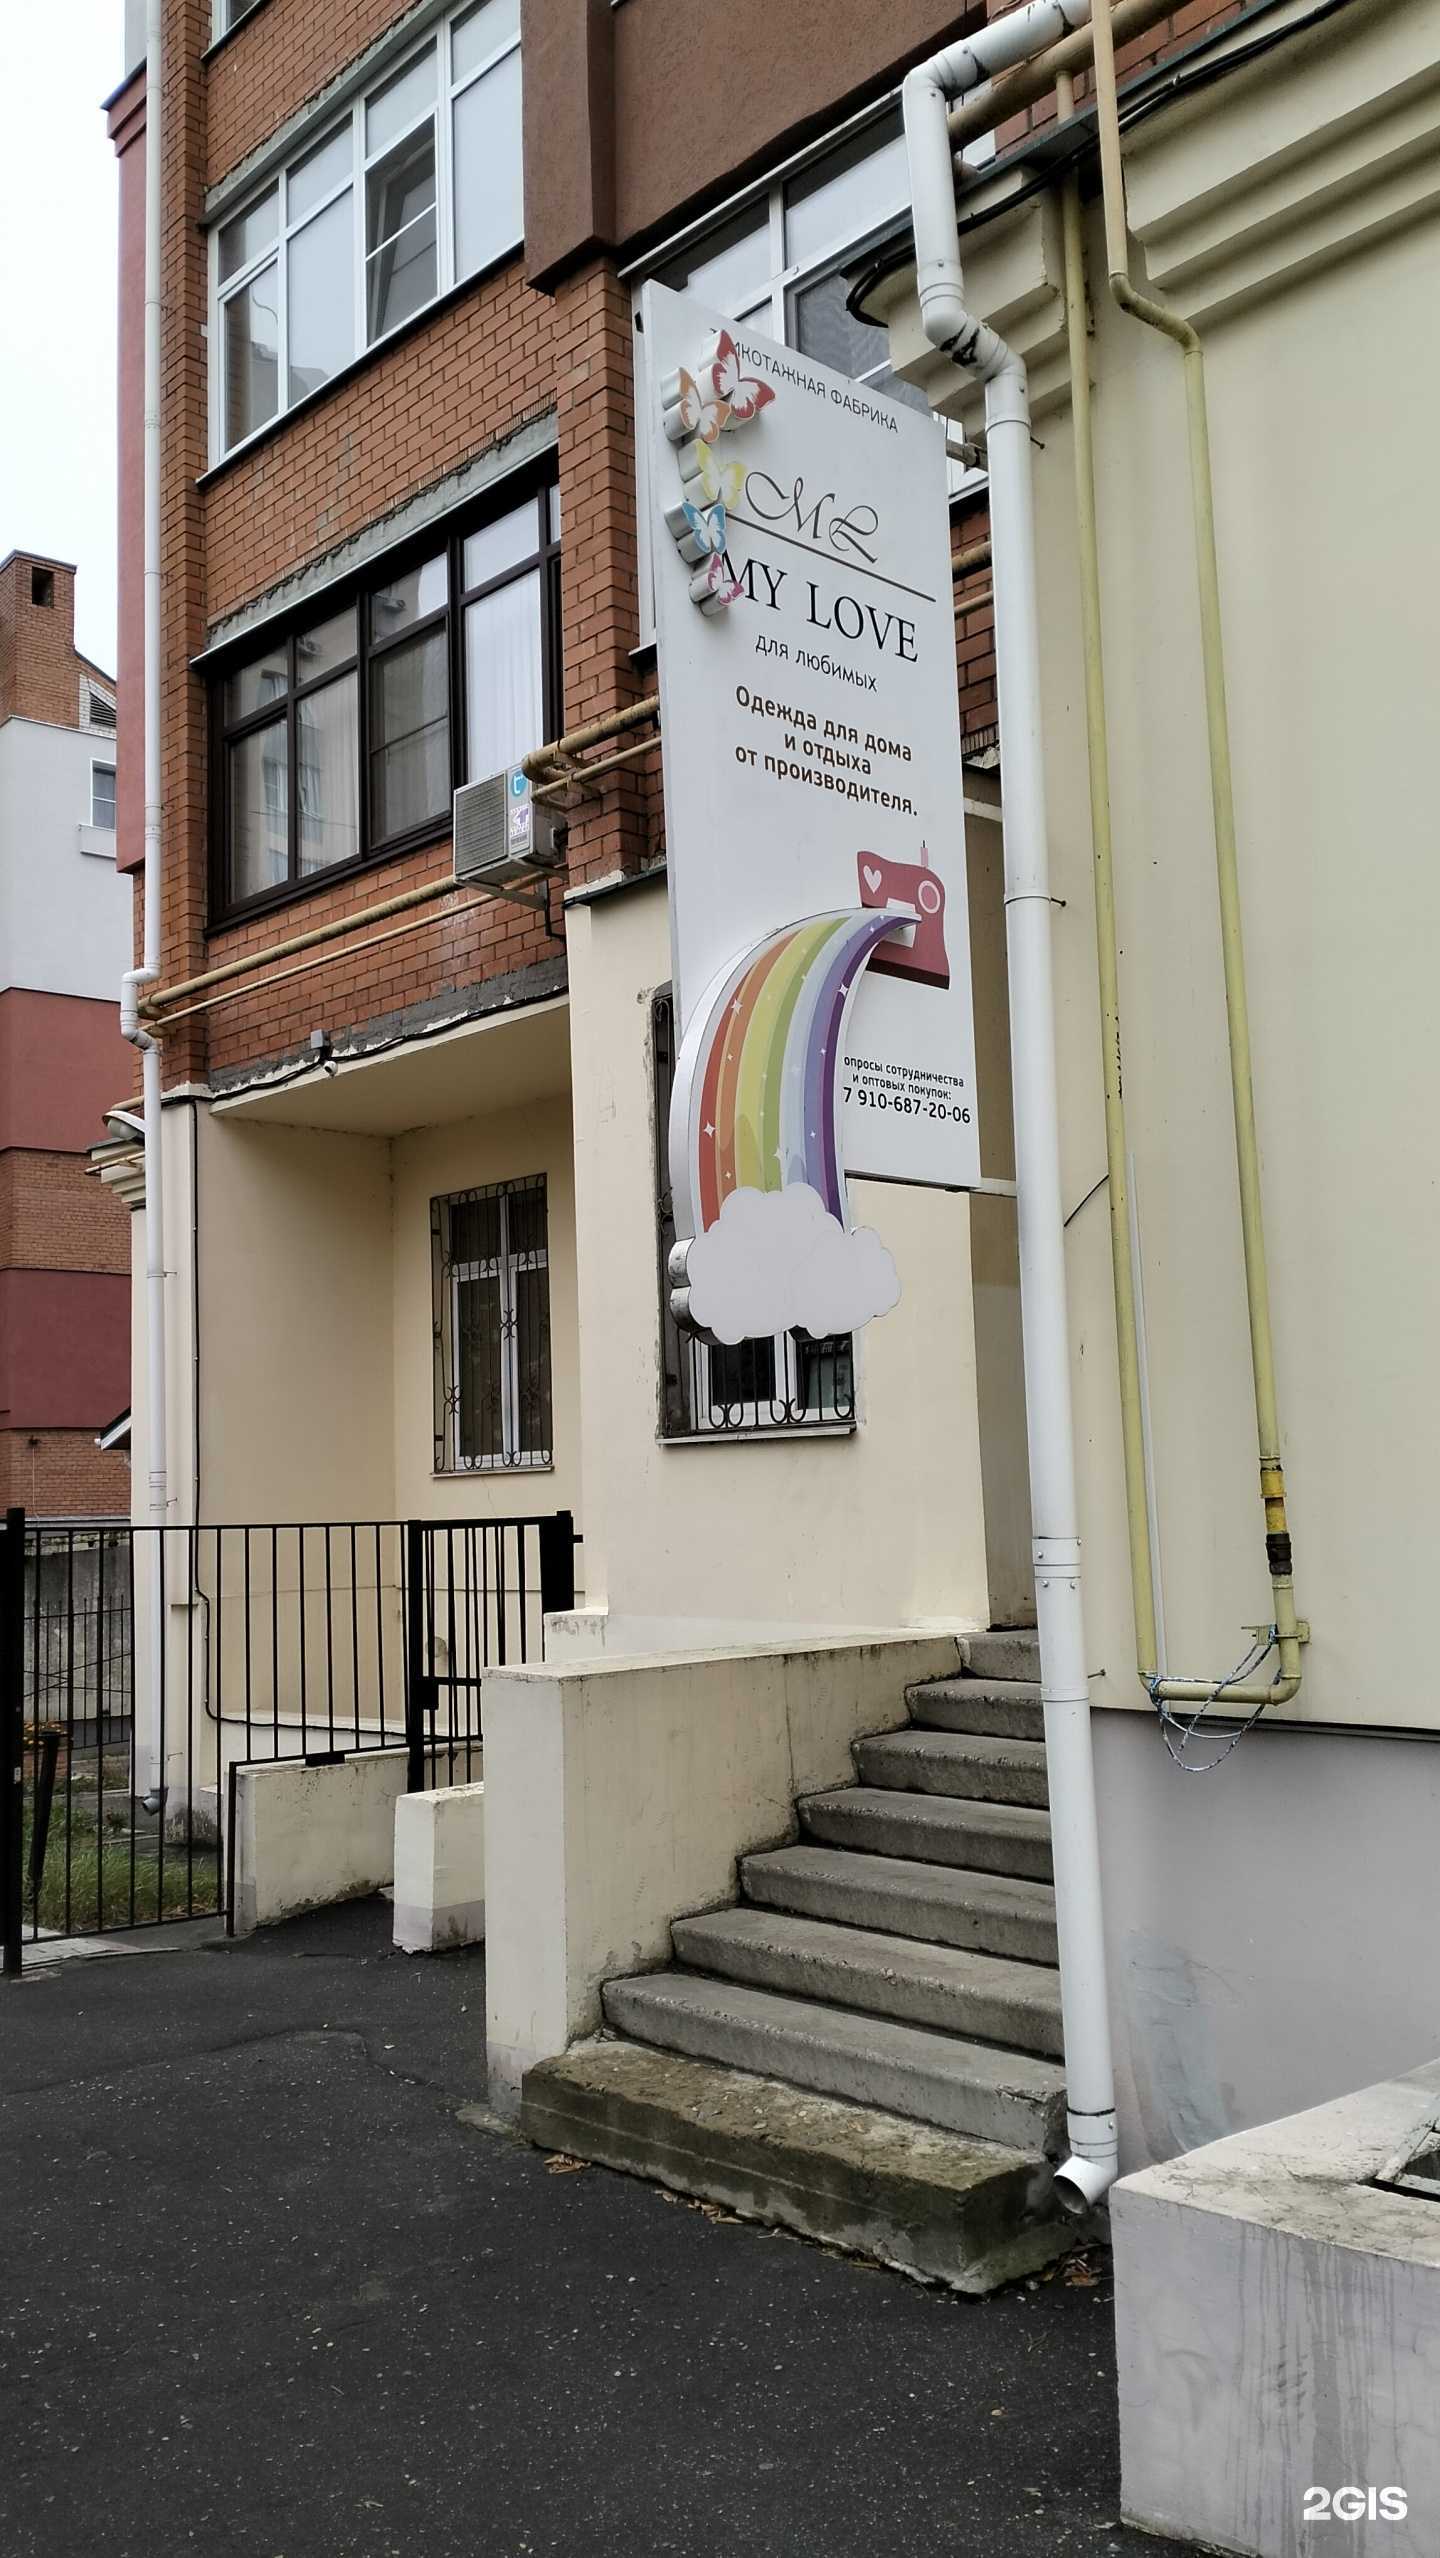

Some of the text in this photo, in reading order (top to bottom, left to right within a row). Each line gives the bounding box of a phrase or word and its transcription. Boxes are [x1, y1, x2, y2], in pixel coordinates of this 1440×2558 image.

[831, 389, 898, 432] ФАБРИКА
[721, 550, 919, 662] MY LOVE
[755, 635, 878, 692] для любимых
[735, 686, 912, 761] Одежда для дома
[784, 734, 872, 774] и отдыха
[735, 746, 918, 816] от производителя.
[844, 1056, 964, 1087] опросы сотрудничества
[853, 1074, 952, 1100] и оптовых покупок:
[843, 1087, 970, 1123] 7 910-687-20-06
